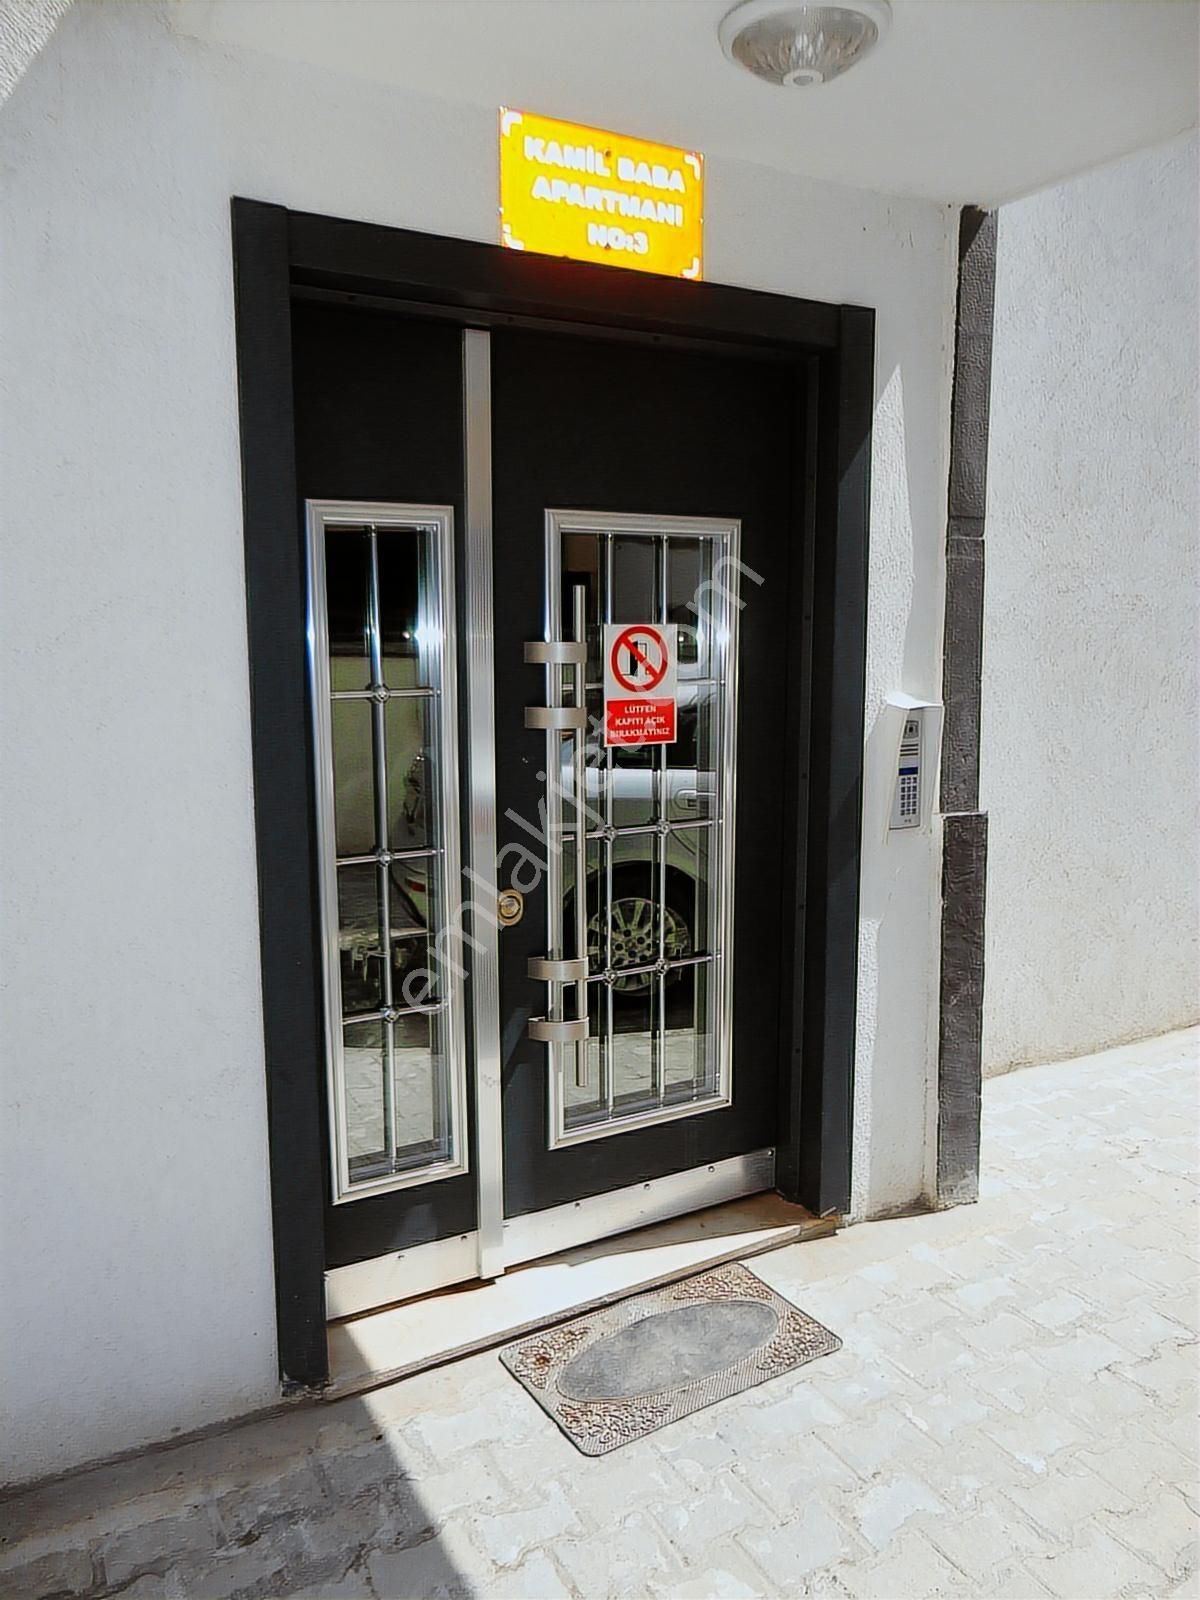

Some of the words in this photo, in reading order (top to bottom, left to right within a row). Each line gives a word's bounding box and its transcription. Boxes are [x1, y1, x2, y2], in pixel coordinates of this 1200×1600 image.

[617, 157, 686, 193] BABA
[531, 175, 684, 228] APARTMANI
[587, 222, 649, 255] NO:3
[615, 717, 644, 726] KAPIYI
[645, 715, 666, 725] AÇIK
[624, 704, 657, 714] LÜTFEN
